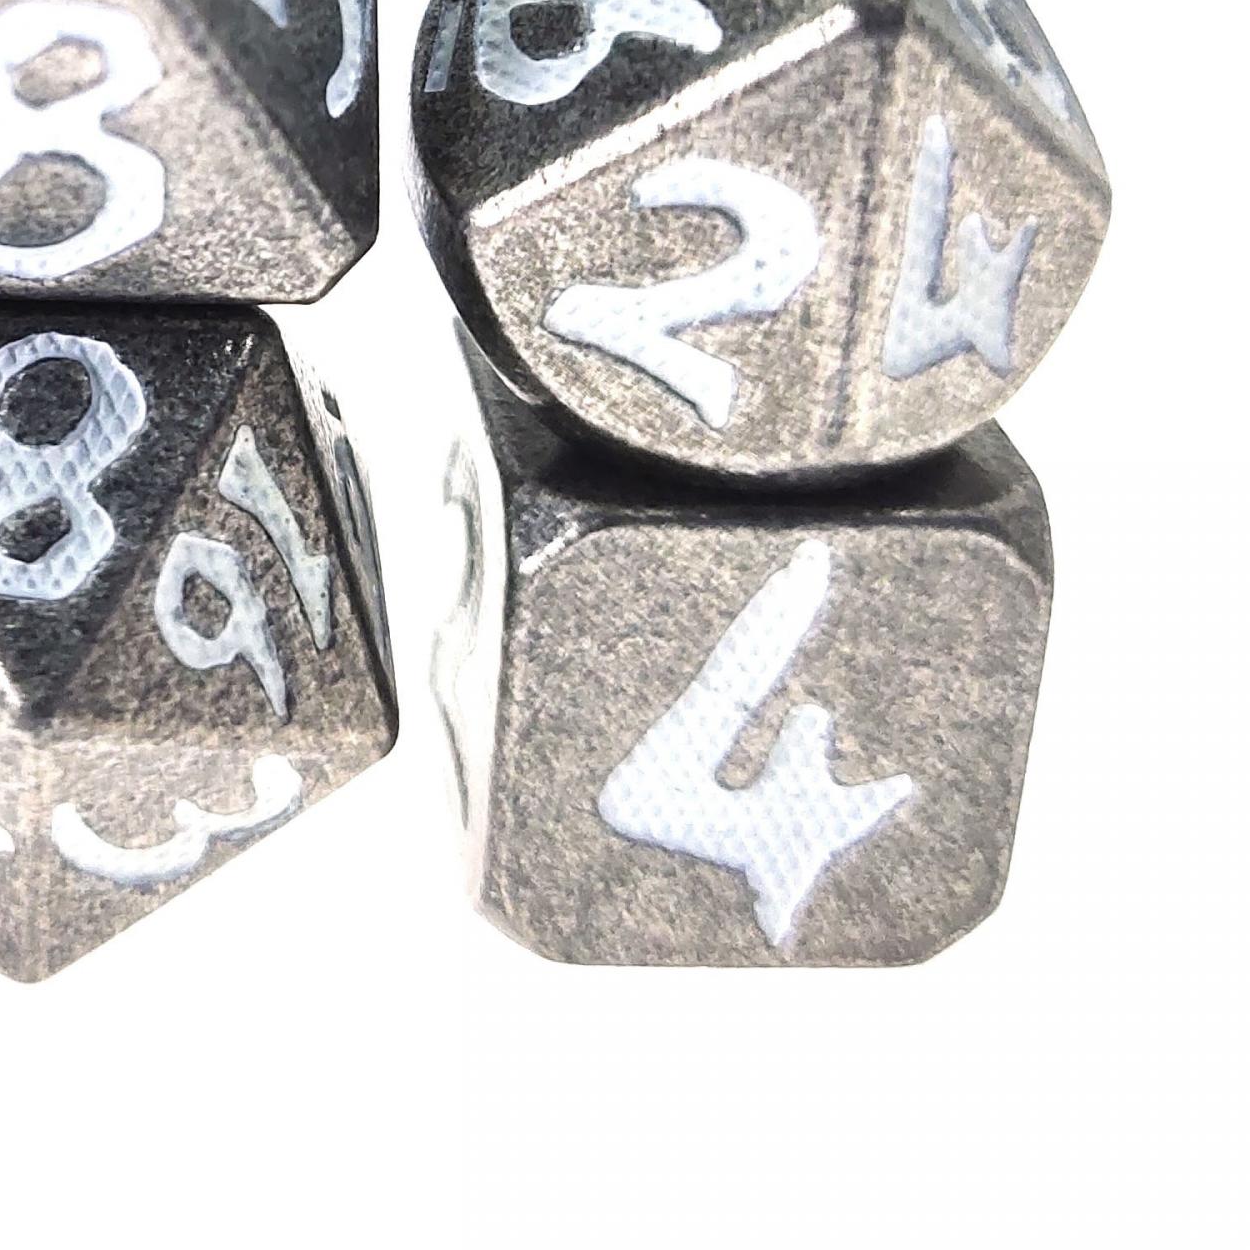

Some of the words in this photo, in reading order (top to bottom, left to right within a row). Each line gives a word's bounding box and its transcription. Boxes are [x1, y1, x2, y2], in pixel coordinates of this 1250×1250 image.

[544, 159, 822, 431] 2
[882, 115, 1039, 381] 4
[51, 753, 303, 886] 3
[599, 537, 913, 947] 4
